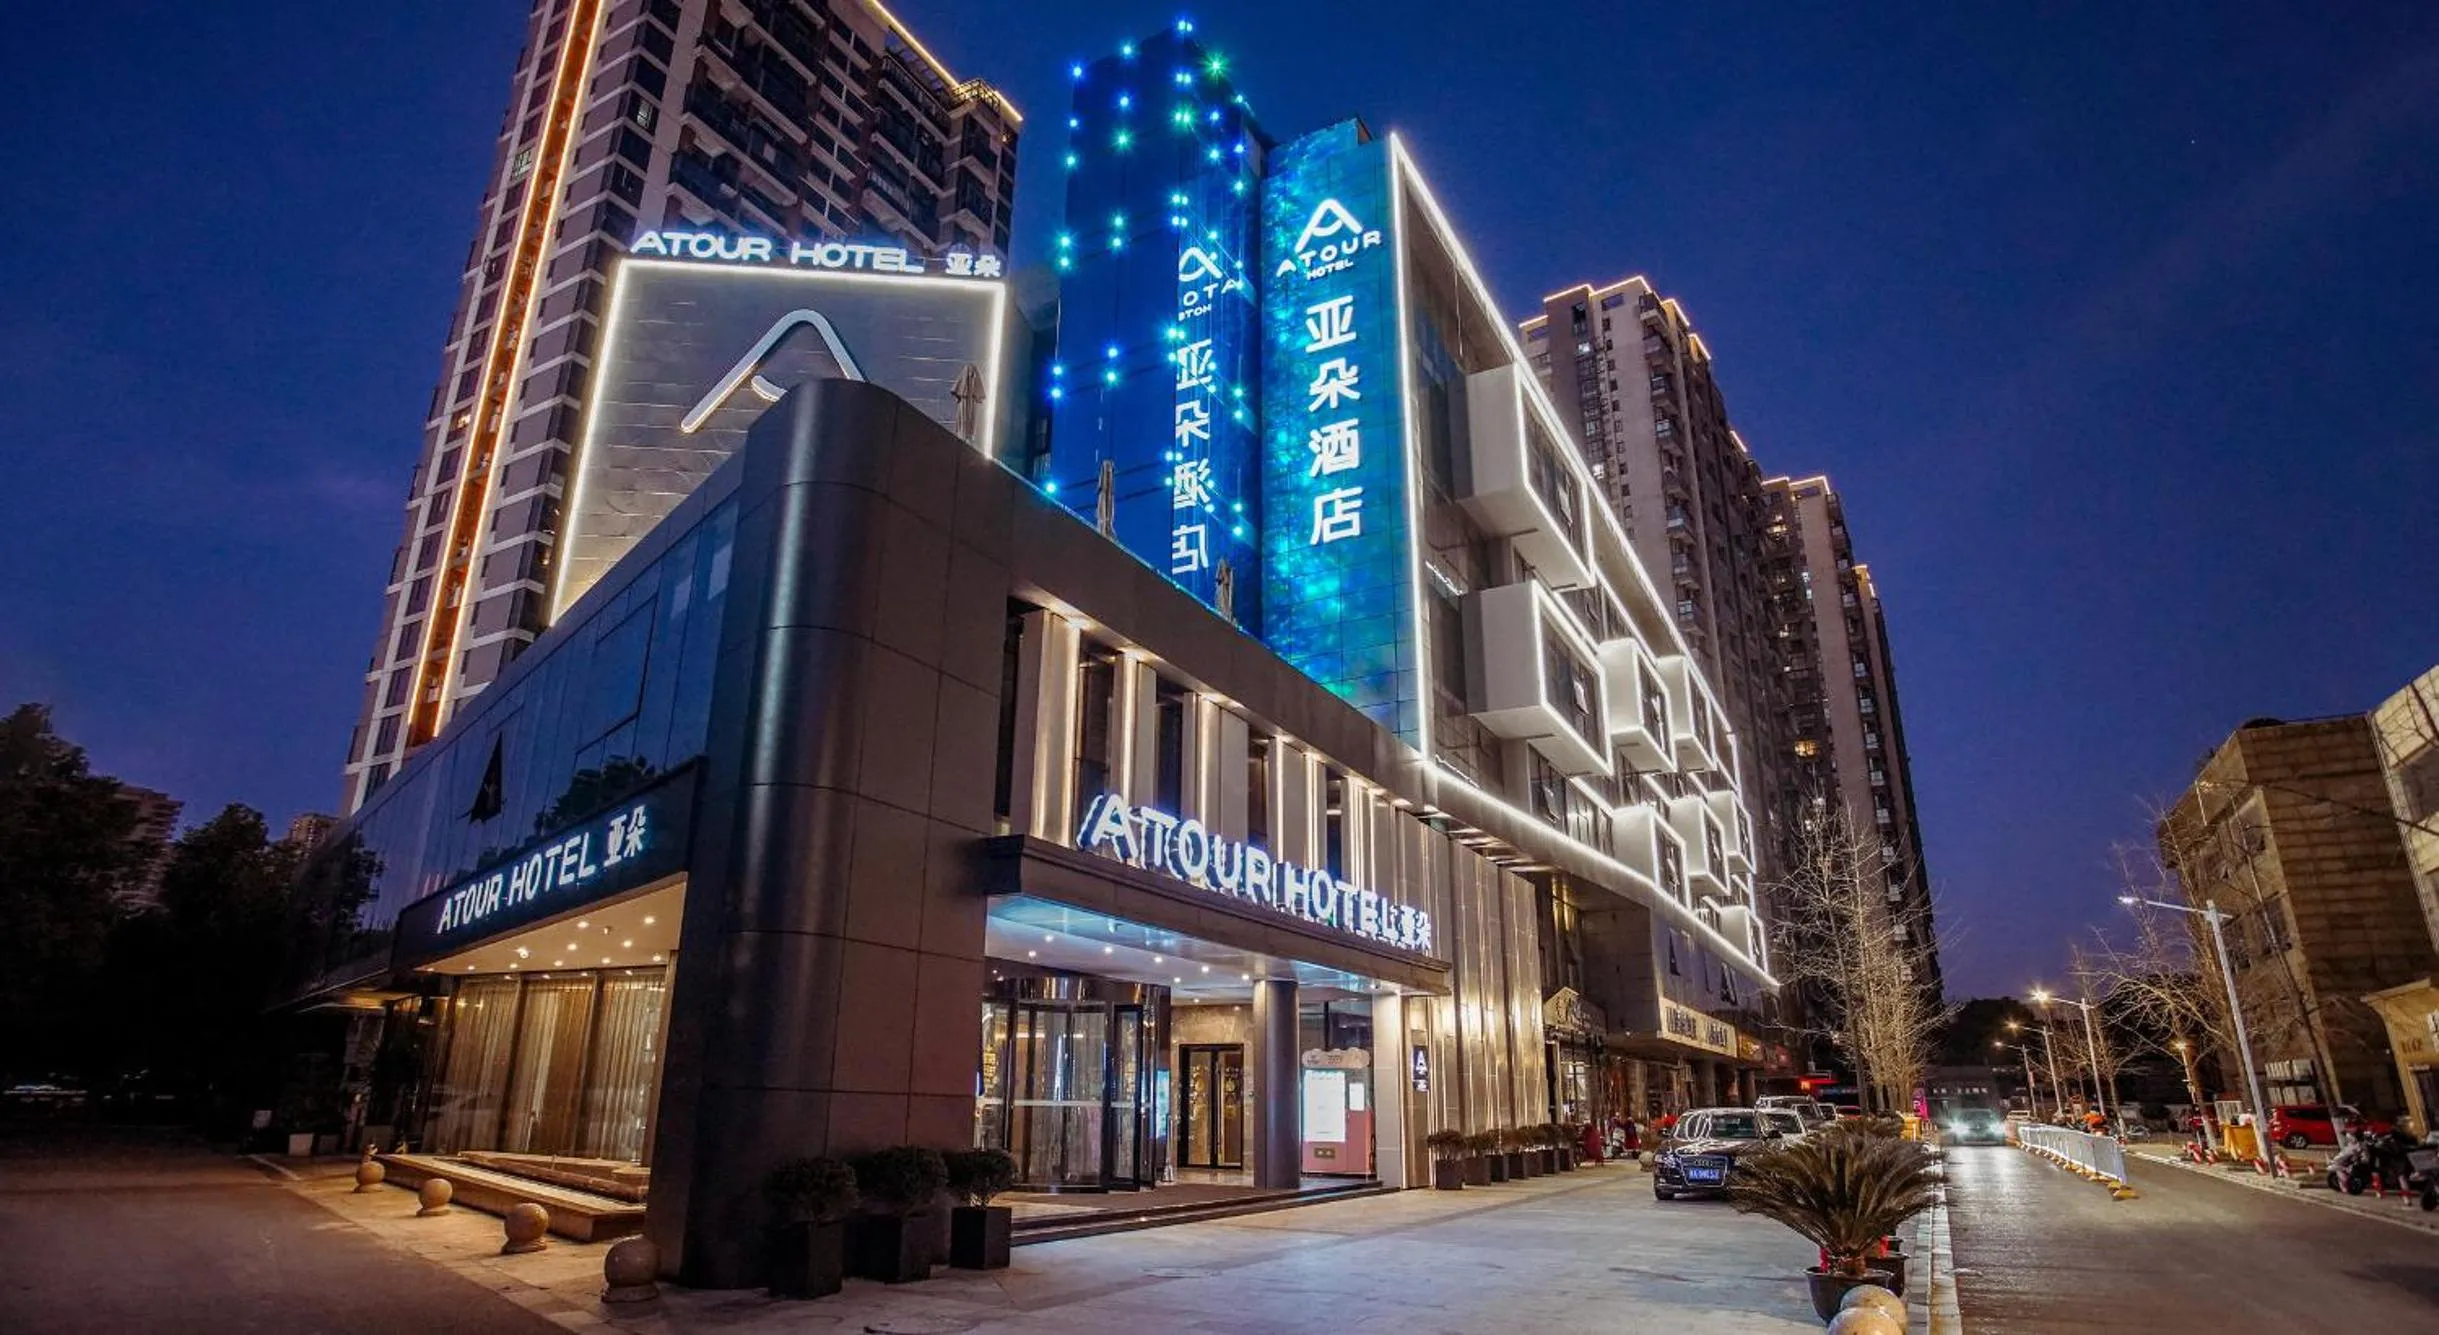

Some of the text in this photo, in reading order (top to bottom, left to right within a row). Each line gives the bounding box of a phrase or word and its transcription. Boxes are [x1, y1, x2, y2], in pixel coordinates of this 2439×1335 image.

[630, 230, 925, 273] ATOUR HOTEL
[946, 252, 1001, 277] 亚朵
[1276, 230, 1382, 278] ATOUR
[1306, 259, 1354, 280] HOTEL
[1305, 295, 1364, 546] 亚朵酒店
[603, 804, 647, 868] 亚朵
[437, 832, 596, 934] ATOUR HOTEL
[1085, 793, 1399, 942] ATOUR HOTEL
